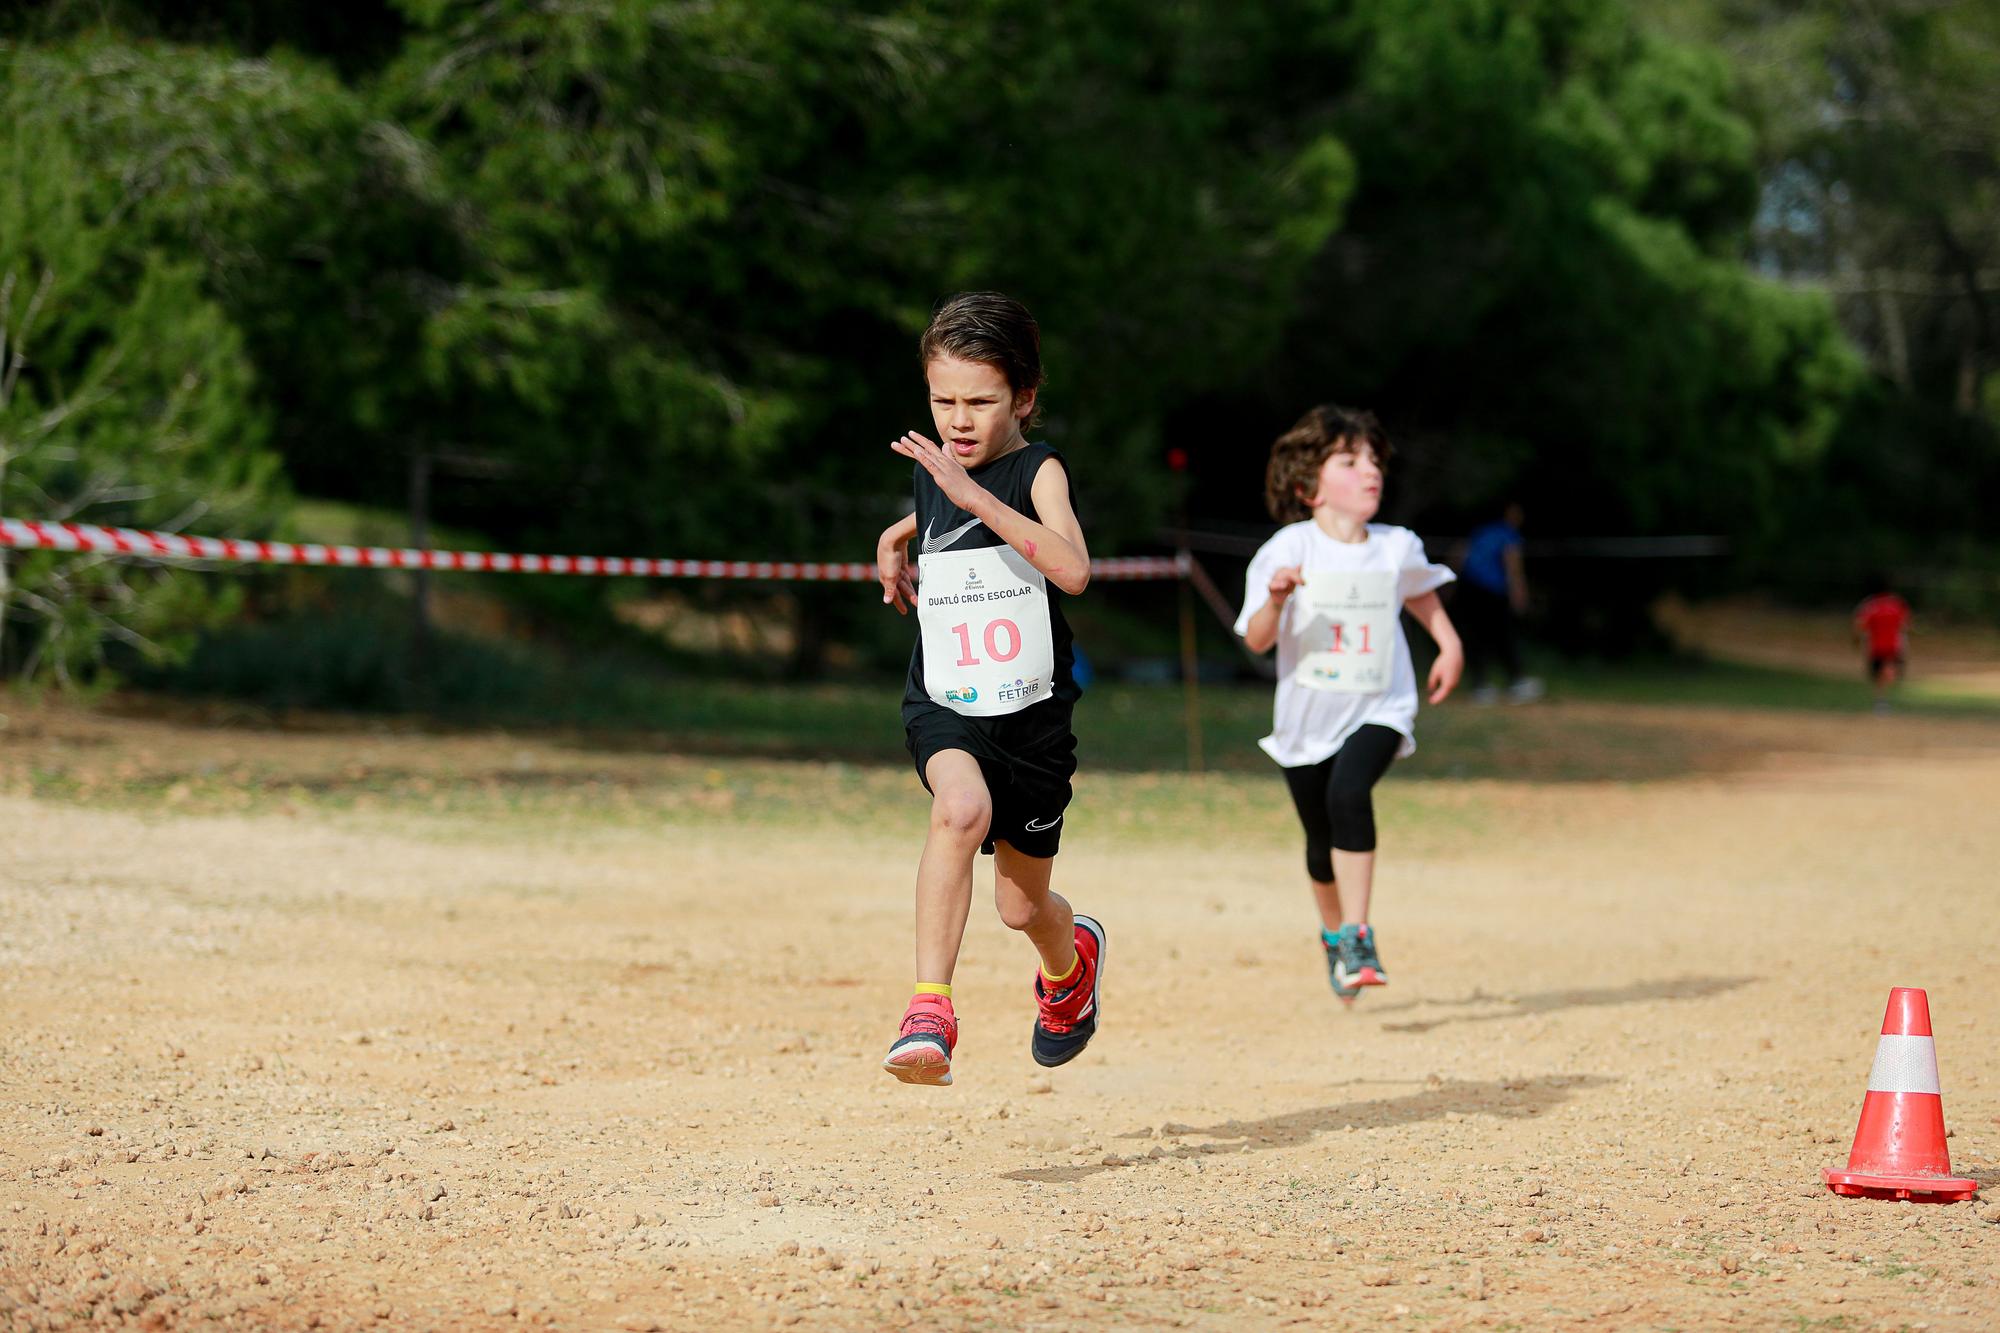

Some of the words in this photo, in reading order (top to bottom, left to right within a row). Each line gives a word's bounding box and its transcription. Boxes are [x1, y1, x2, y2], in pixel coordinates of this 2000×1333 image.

[928, 593, 959, 606] DUATLÓ
[961, 593, 985, 604] CROS
[987, 586, 1032, 601] ESCOLAR
[951, 618, 1022, 667] 10
[1328, 623, 1375, 655] 11
[998, 682, 1039, 701] FETRIB
